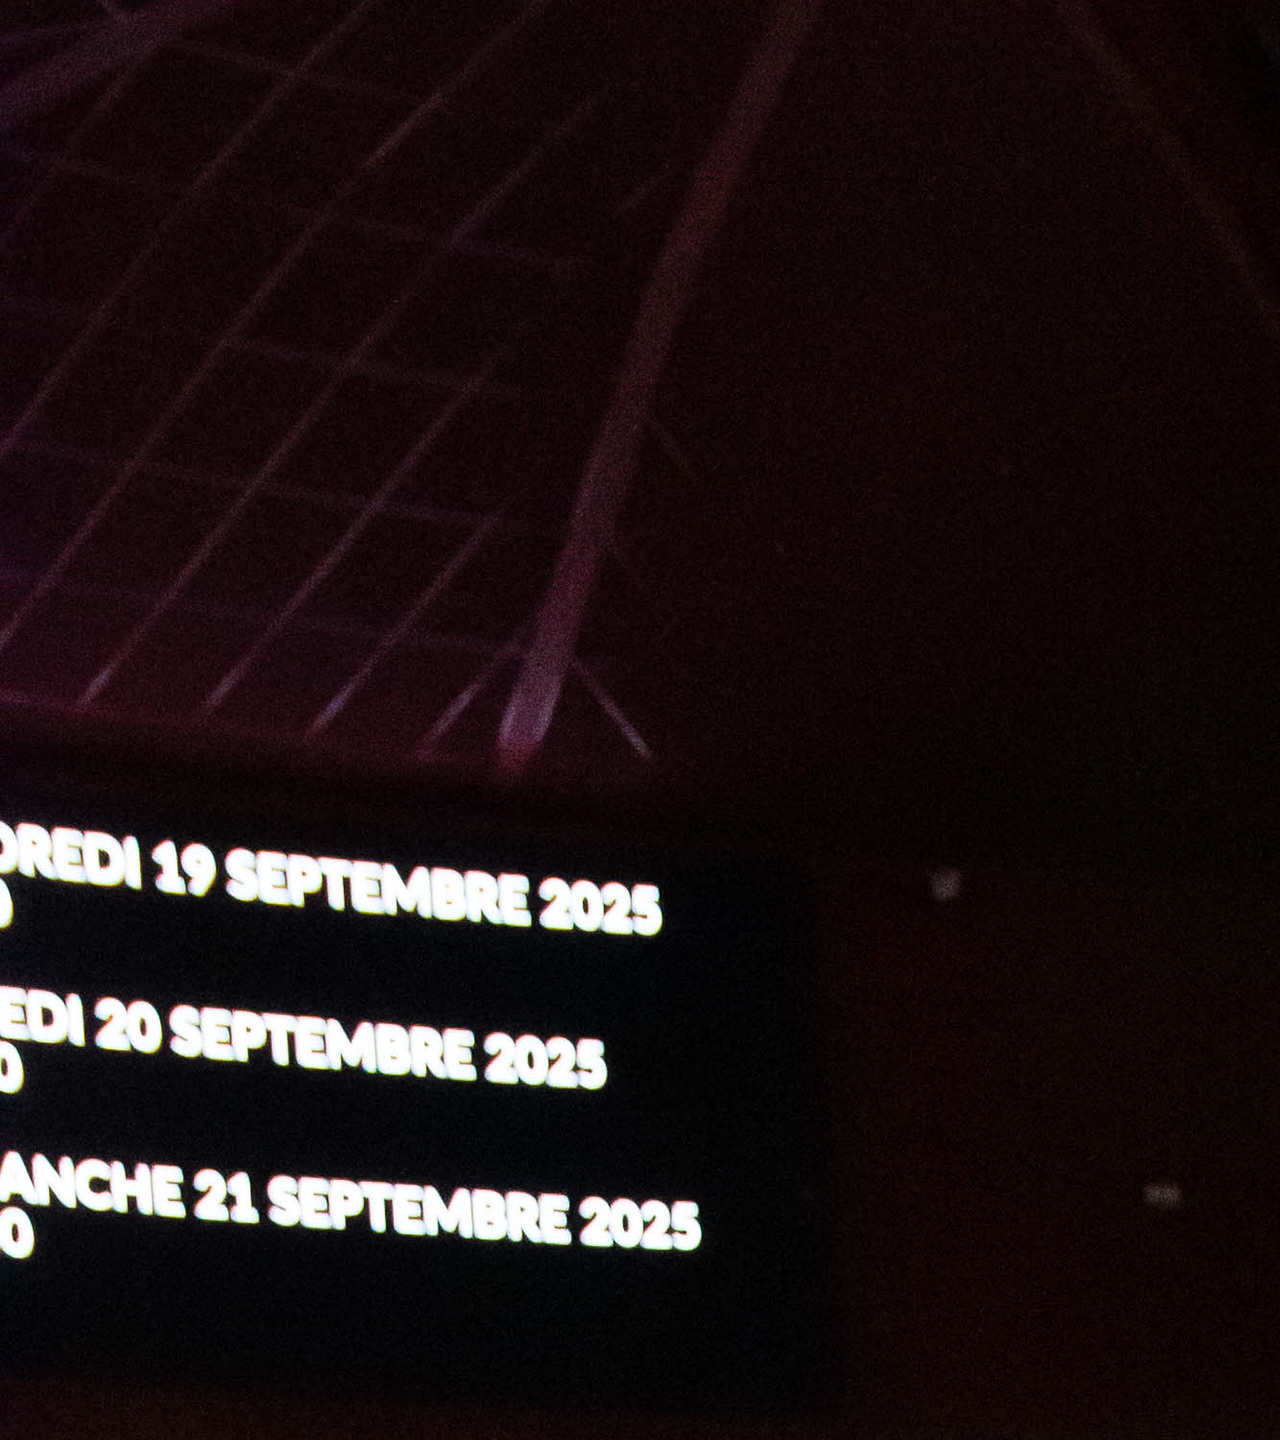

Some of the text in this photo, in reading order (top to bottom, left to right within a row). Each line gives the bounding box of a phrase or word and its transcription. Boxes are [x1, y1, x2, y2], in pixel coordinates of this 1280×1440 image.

[152, 840, 217, 896] 19
[224, 847, 532, 927] SEPTEMBRE
[538, 876, 664, 937] 2025
[94, 997, 163, 1054] 20
[168, 1004, 478, 1081] SEPTEMBRE
[483, 1031, 608, 1090] 2025
[192, 1168, 260, 1224] 21
[266, 1174, 573, 1246] SEPTEMBRE
[578, 1195, 702, 1251] 2025
